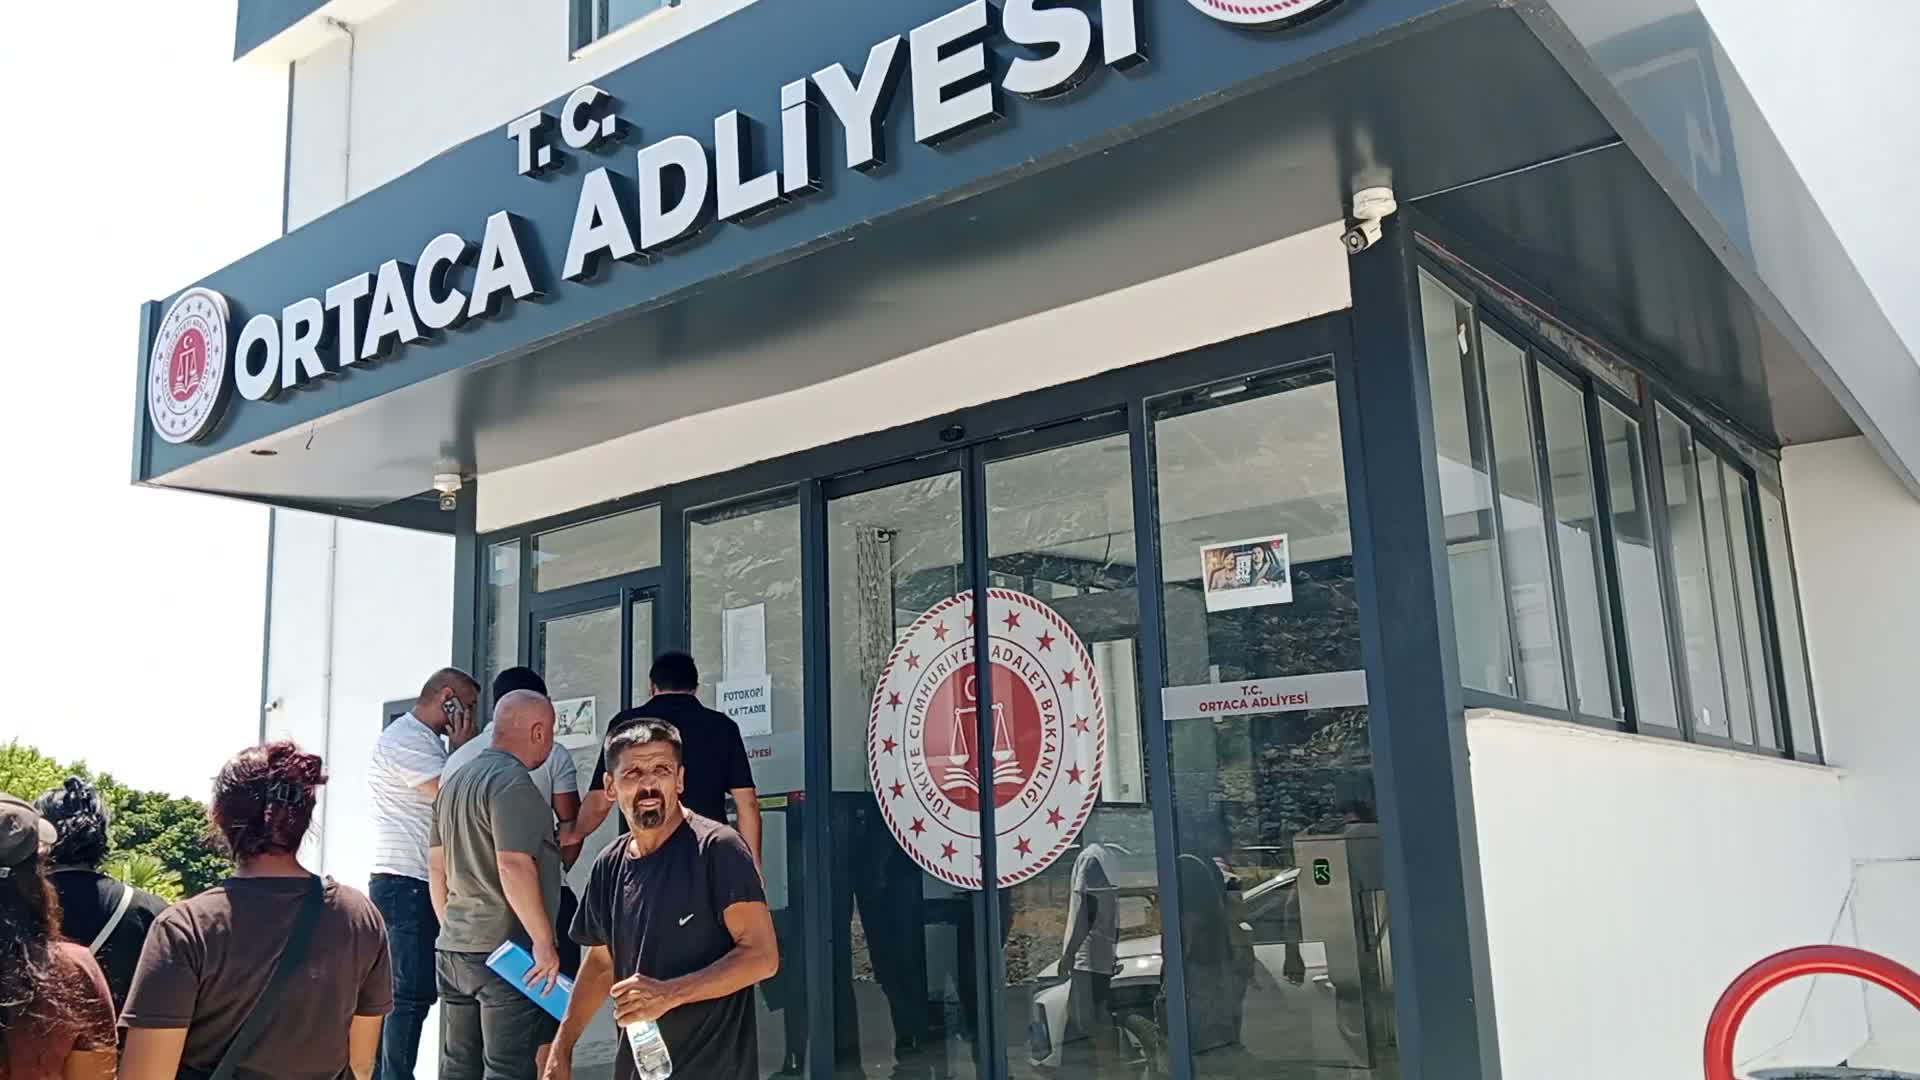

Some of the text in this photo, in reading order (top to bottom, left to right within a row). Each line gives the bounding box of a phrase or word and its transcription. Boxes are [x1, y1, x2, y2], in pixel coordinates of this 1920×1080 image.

[234, 209, 535, 401] ORTACA
[991, 644, 1047, 693] ADALET
[1020, 698, 1057, 809] BAKANLIĞI
[1199, 690, 1309, 712] ORTACA ADLİYESİ
[1241, 685, 1263, 696] T.C.
